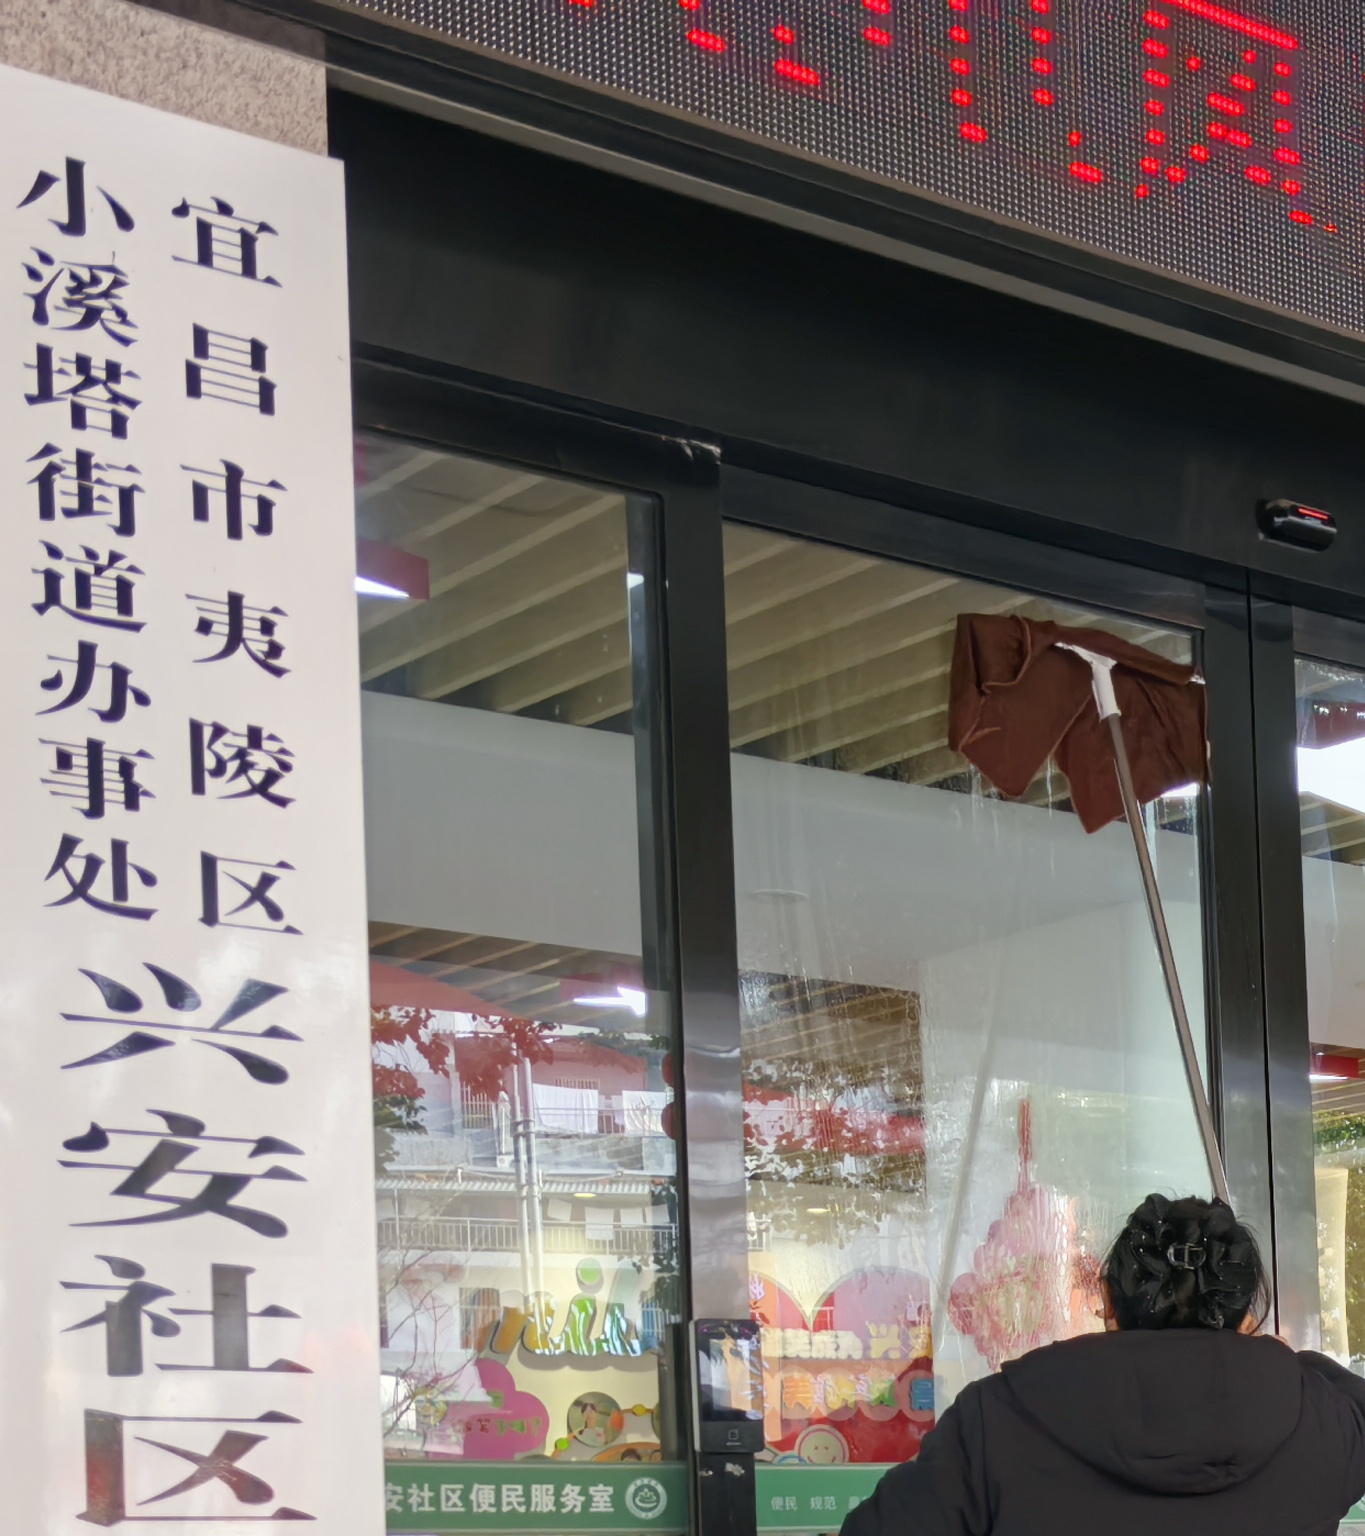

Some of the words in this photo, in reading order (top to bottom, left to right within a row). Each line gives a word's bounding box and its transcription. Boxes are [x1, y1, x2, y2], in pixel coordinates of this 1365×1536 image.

[15, 156, 159, 921] 小溪塔街道办事处
[171, 196, 304, 935] 宜昌市夷陵区
